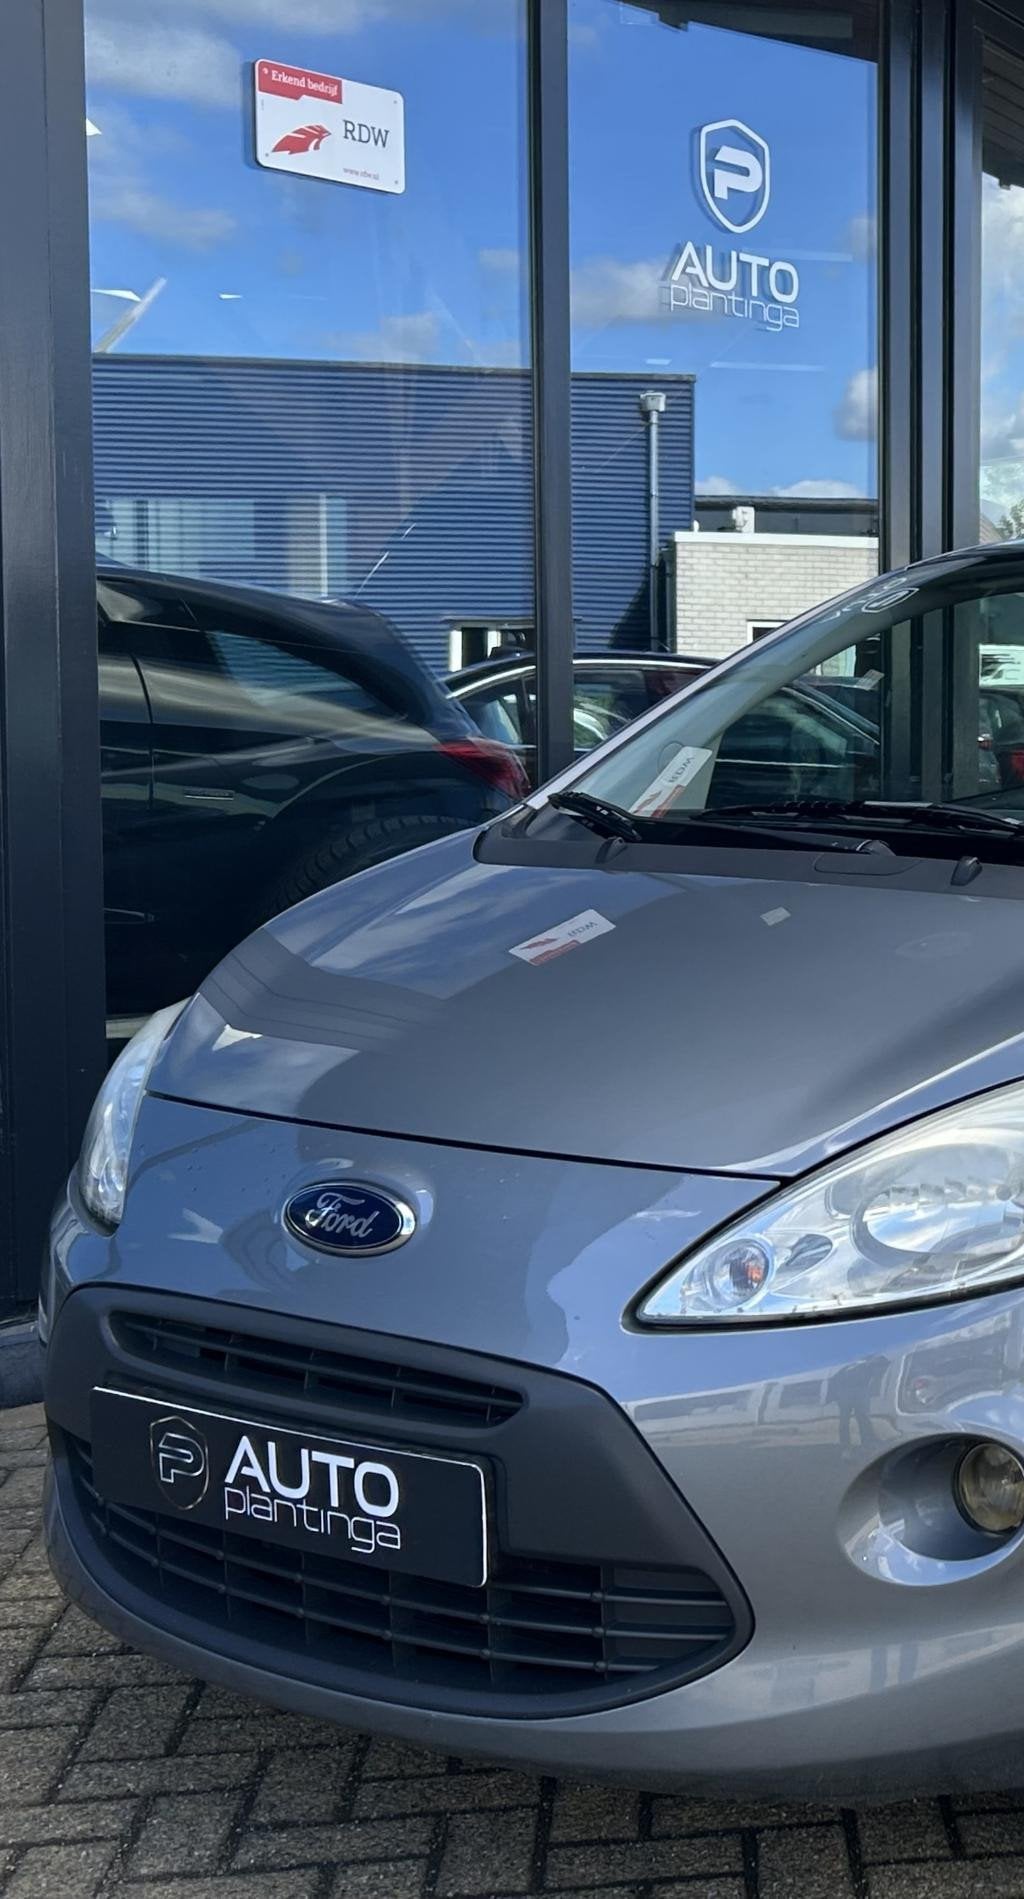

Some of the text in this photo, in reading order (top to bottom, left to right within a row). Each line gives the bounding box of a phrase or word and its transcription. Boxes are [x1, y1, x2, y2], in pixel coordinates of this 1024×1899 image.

[271, 69, 339, 97] Erkend bedrijf
[343, 119, 390, 149] RDW
[671, 240, 799, 303] AUTO
[670, 282, 800, 332] plantinga
[304, 1192, 380, 1238] Ford
[224, 1435, 400, 1519] AUTO
[224, 1485, 401, 1554] plantinga
